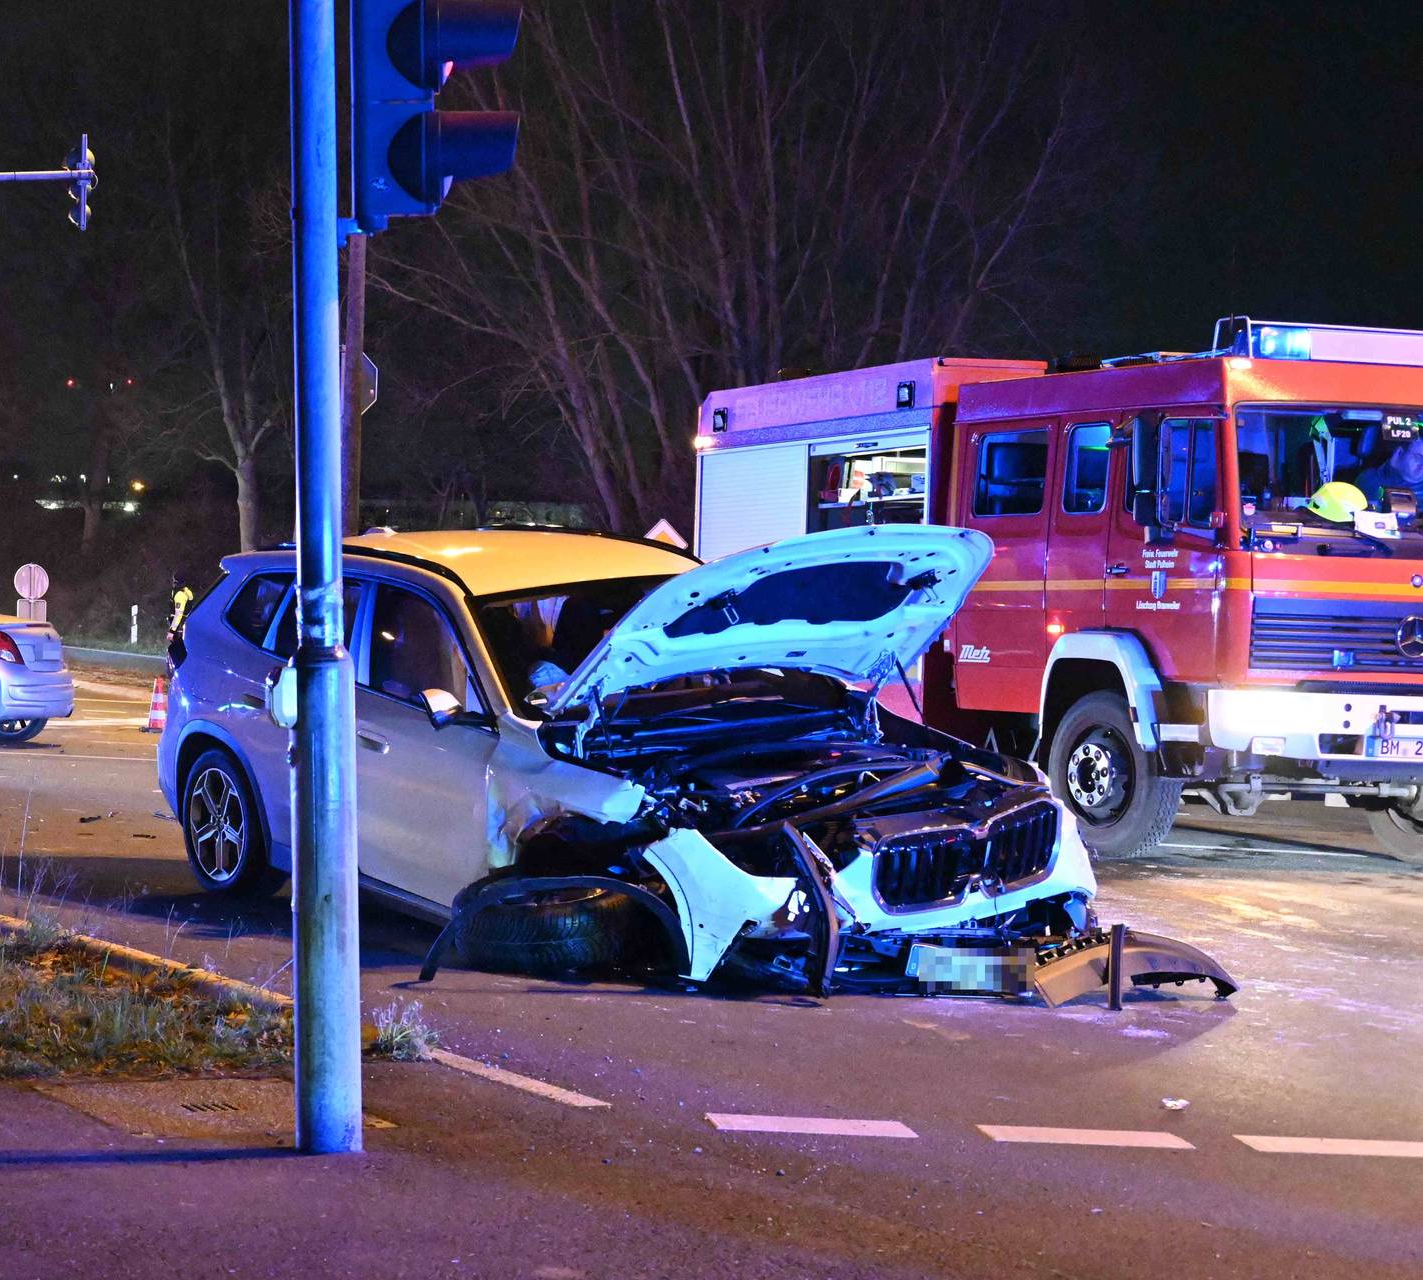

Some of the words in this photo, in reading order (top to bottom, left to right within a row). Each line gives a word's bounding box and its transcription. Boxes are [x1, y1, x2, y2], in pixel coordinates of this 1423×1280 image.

[1387, 416, 1405, 425] PUL
[1405, 417, 1412, 426] 2
[1391, 430, 1411, 438] LF20
[1380, 739, 1399, 755] BM
